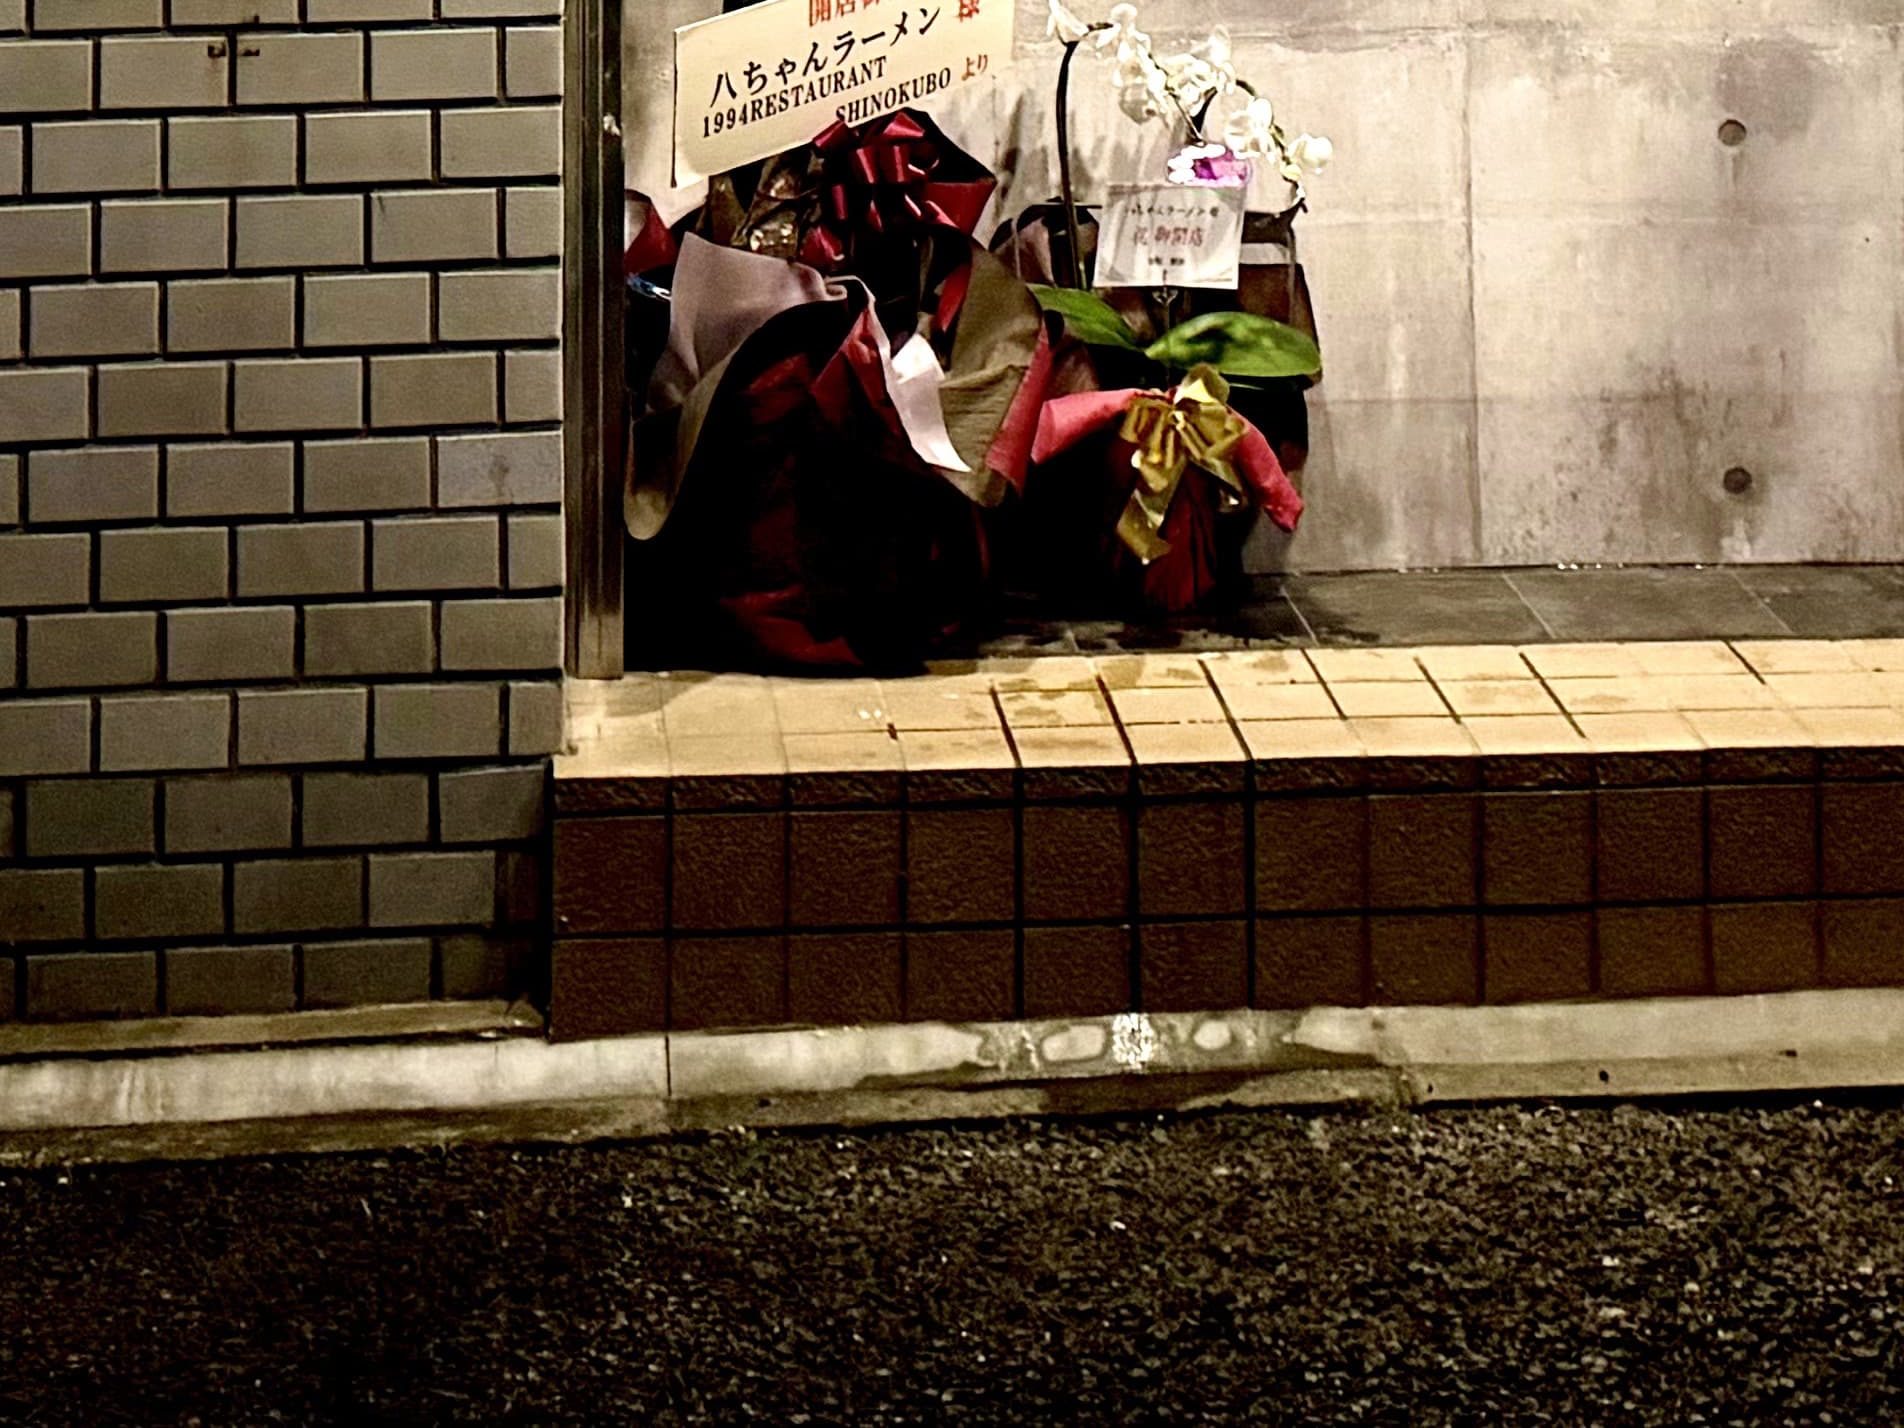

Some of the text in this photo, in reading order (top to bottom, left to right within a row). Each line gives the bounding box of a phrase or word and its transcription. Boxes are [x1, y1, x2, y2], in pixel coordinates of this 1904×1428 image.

[702, 55, 887, 139] 1994RESTAURANT
[835, 53, 989, 125] SHINOKUBO より
